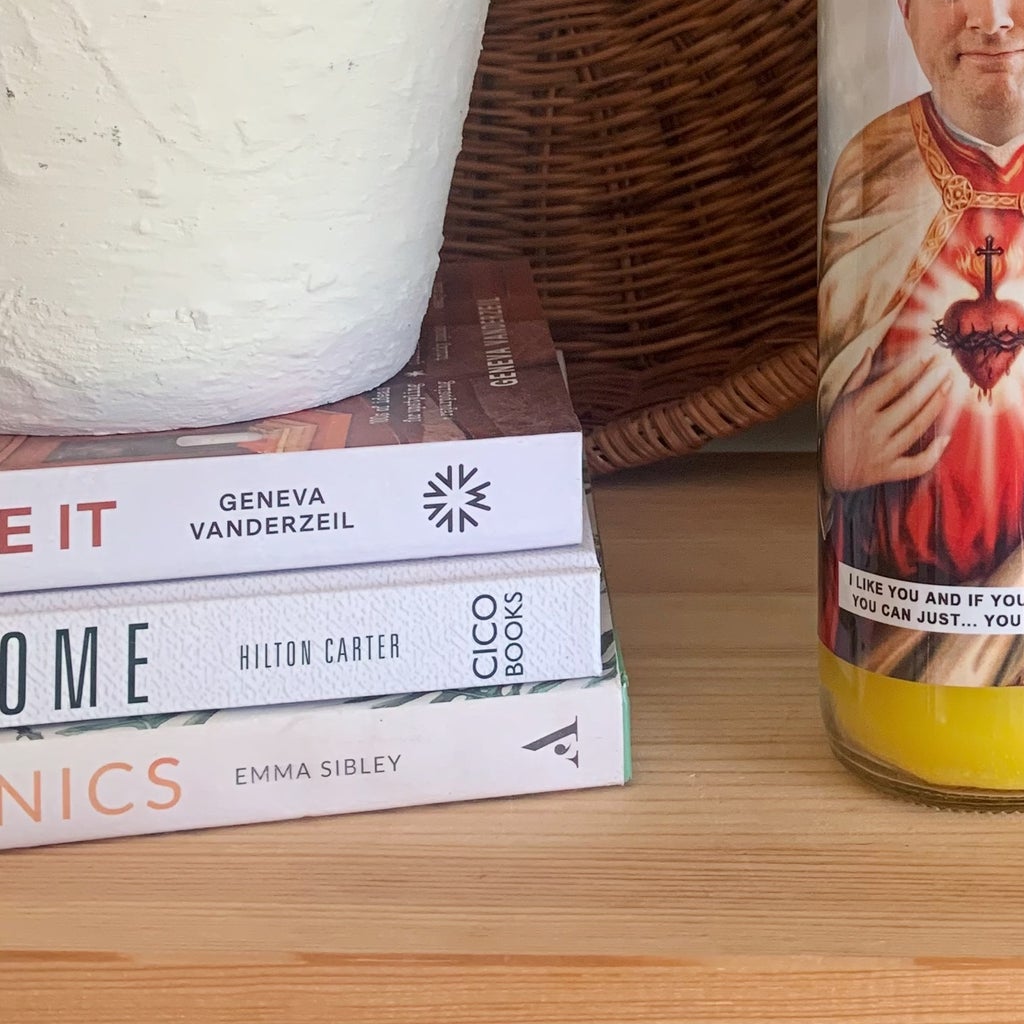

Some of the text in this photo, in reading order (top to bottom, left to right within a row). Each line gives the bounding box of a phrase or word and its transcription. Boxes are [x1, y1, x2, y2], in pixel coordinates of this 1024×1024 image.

[476, 297, 519, 387] GENEVA VANDERZEIL
[219, 487, 326, 511] GENEVA
[59, 500, 117, 550] IT
[190, 512, 355, 540] VANDERZEIL
[849, 573, 853, 586] I
[856, 575, 883, 595] LIKE
[888, 585, 919, 602] YOU
[925, 592, 961, 606] AND
[968, 594, 984, 607] IF
[852, 594, 876, 613] YOU
[881, 604, 911, 621] CAN
[917, 611, 977, 627] JUST...
[984, 614, 1021, 627] YOU
[240, 633, 399, 670] HILTON CARTER
[472, 594, 498, 679] CICO
[504, 591, 524, 677] BOOKS
[0, 622, 149, 716] OME
[235, 754, 402, 785] EMMA SIBLEY
[0, 757, 182, 826] NICS
